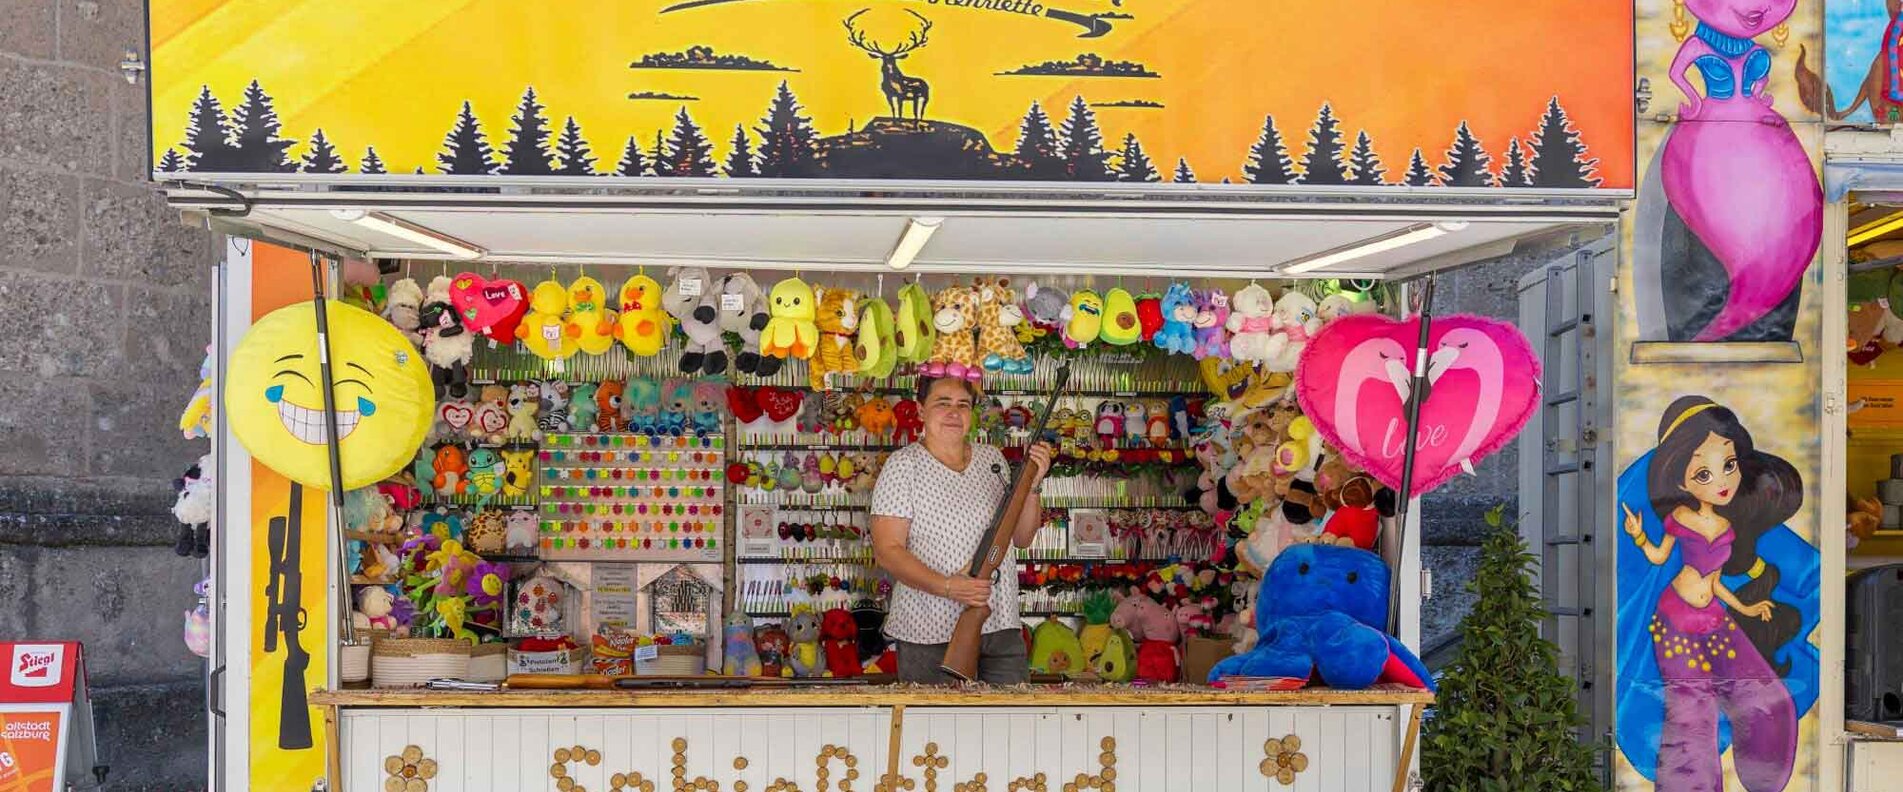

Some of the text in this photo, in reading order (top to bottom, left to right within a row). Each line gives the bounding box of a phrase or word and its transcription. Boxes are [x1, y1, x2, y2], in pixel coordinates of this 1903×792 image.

[484, 290, 506, 300] Love
[5, 721, 50, 731] altstadt
[0, 731, 50, 742] salzburg
